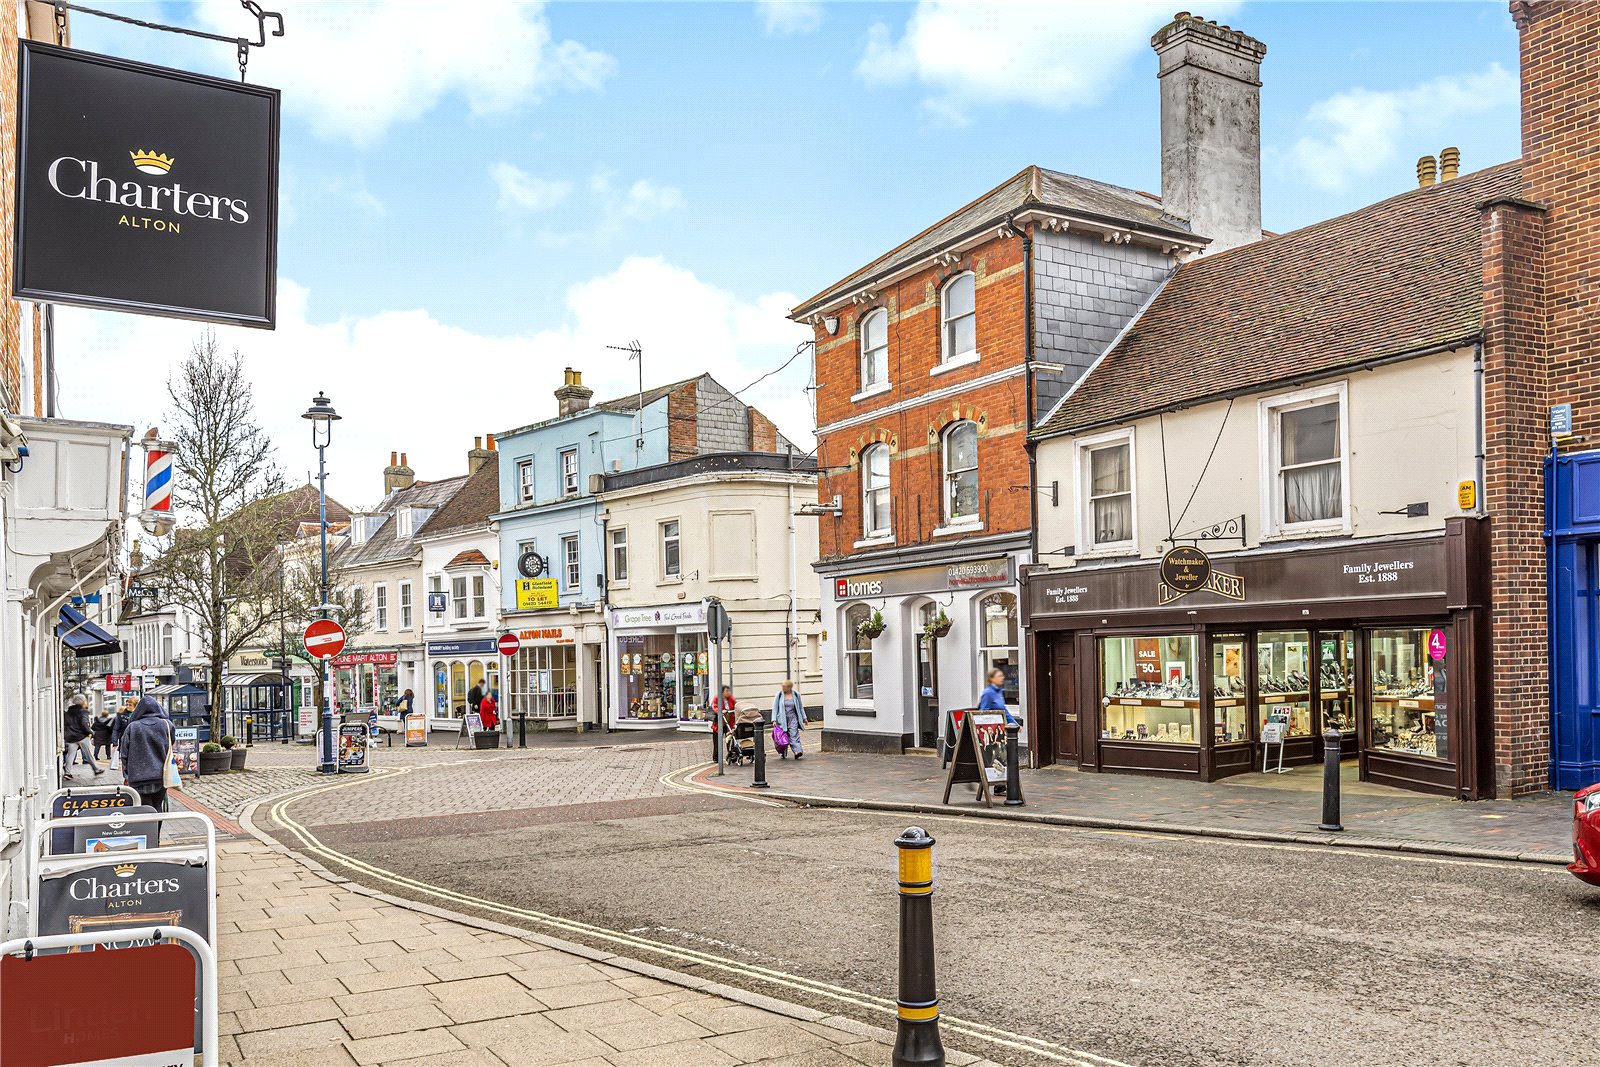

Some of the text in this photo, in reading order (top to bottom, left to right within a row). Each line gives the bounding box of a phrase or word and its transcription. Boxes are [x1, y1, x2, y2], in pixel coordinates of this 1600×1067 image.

[48, 156, 249, 224] Charters
[118, 214, 181, 234] ALTON
[1168, 557, 1204, 566] Watchmaker
[1343, 560, 1414, 575] Family Jewellers
[949, 564, 988, 576] 01420 593900
[1174, 573, 1198, 581] Jeweller
[1358, 571, 1398, 584] Est. 1888
[847, 579, 882, 597] homes
[1046, 586, 1088, 596] Family Jewellers
[624, 614, 640, 625] Grape
[640, 613, 652, 622] Tree
[519, 628, 562, 640] ALTON NAILS
[1431, 633, 1440, 649] 4
[240, 655, 268, 666] Waterstones
[352, 654, 368, 662] MART
[370, 653, 388, 661] ALTON
[1142, 663, 1155, 673] 50
[62, 798, 126, 810] CLASSIC
[62, 809, 80, 817] BA
[69, 877, 180, 901] Charters
[108, 899, 143, 909] ALTON
